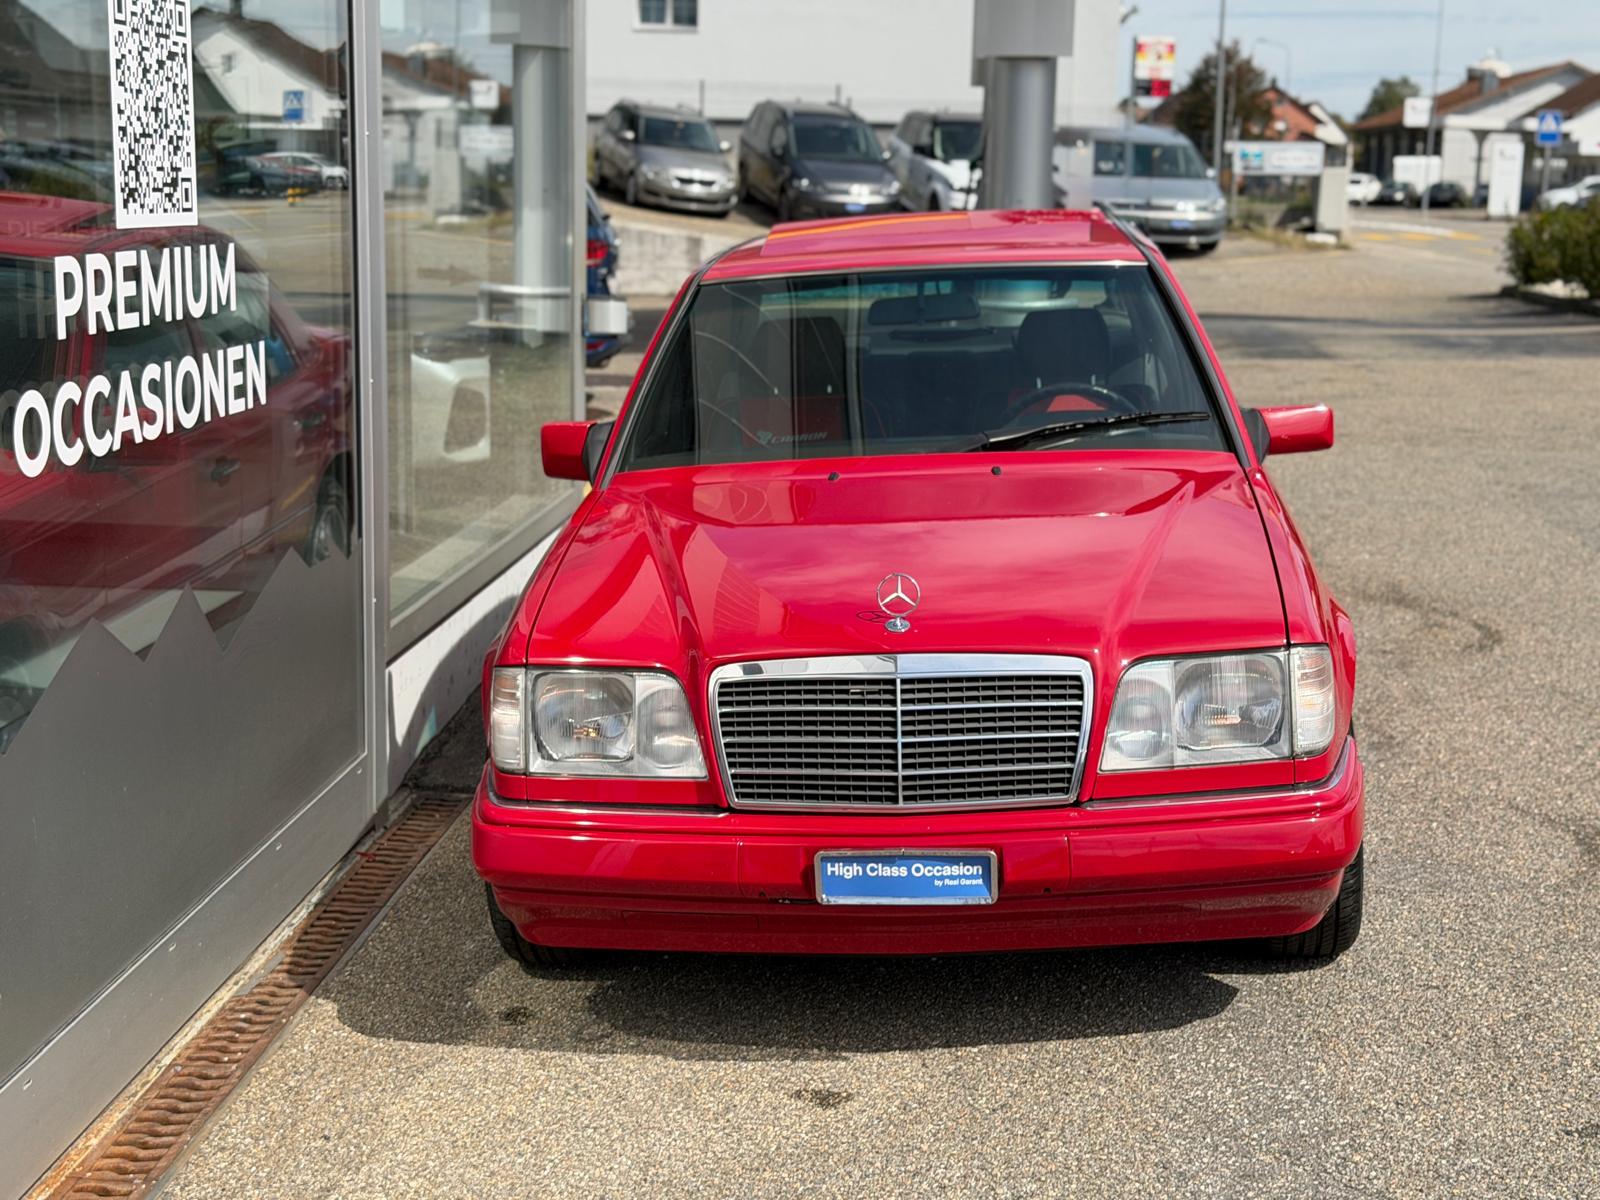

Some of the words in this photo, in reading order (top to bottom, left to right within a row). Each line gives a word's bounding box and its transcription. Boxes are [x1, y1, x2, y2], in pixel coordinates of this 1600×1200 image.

[54, 242, 237, 341] PREMIUM
[13, 340, 267, 478] OCCASIONEN
[826, 862, 863, 879] High
[866, 862, 908, 877] Class
[911, 861, 983, 877] Occasion
[934, 878, 944, 888] by
[960, 877, 984, 886] Garant
